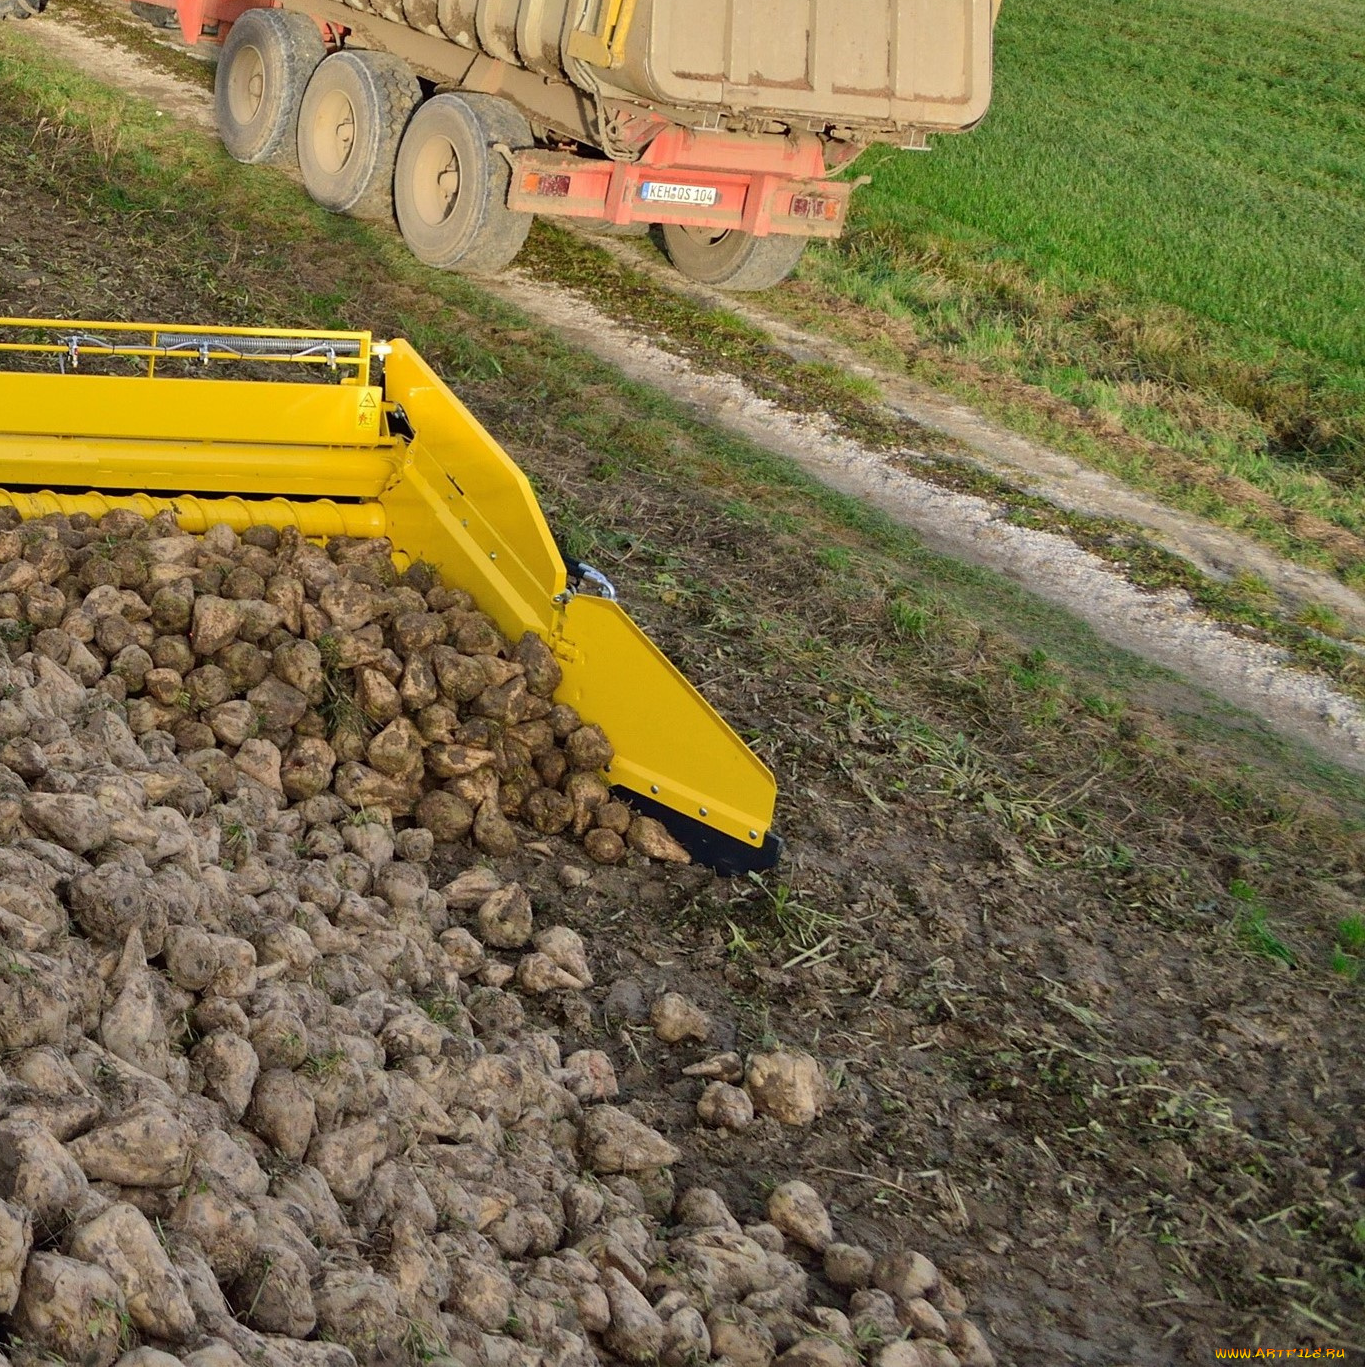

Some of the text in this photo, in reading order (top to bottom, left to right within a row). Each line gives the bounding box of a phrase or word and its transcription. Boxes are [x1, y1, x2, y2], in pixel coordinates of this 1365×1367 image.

[650, 185, 712, 202] KEH QS 104
